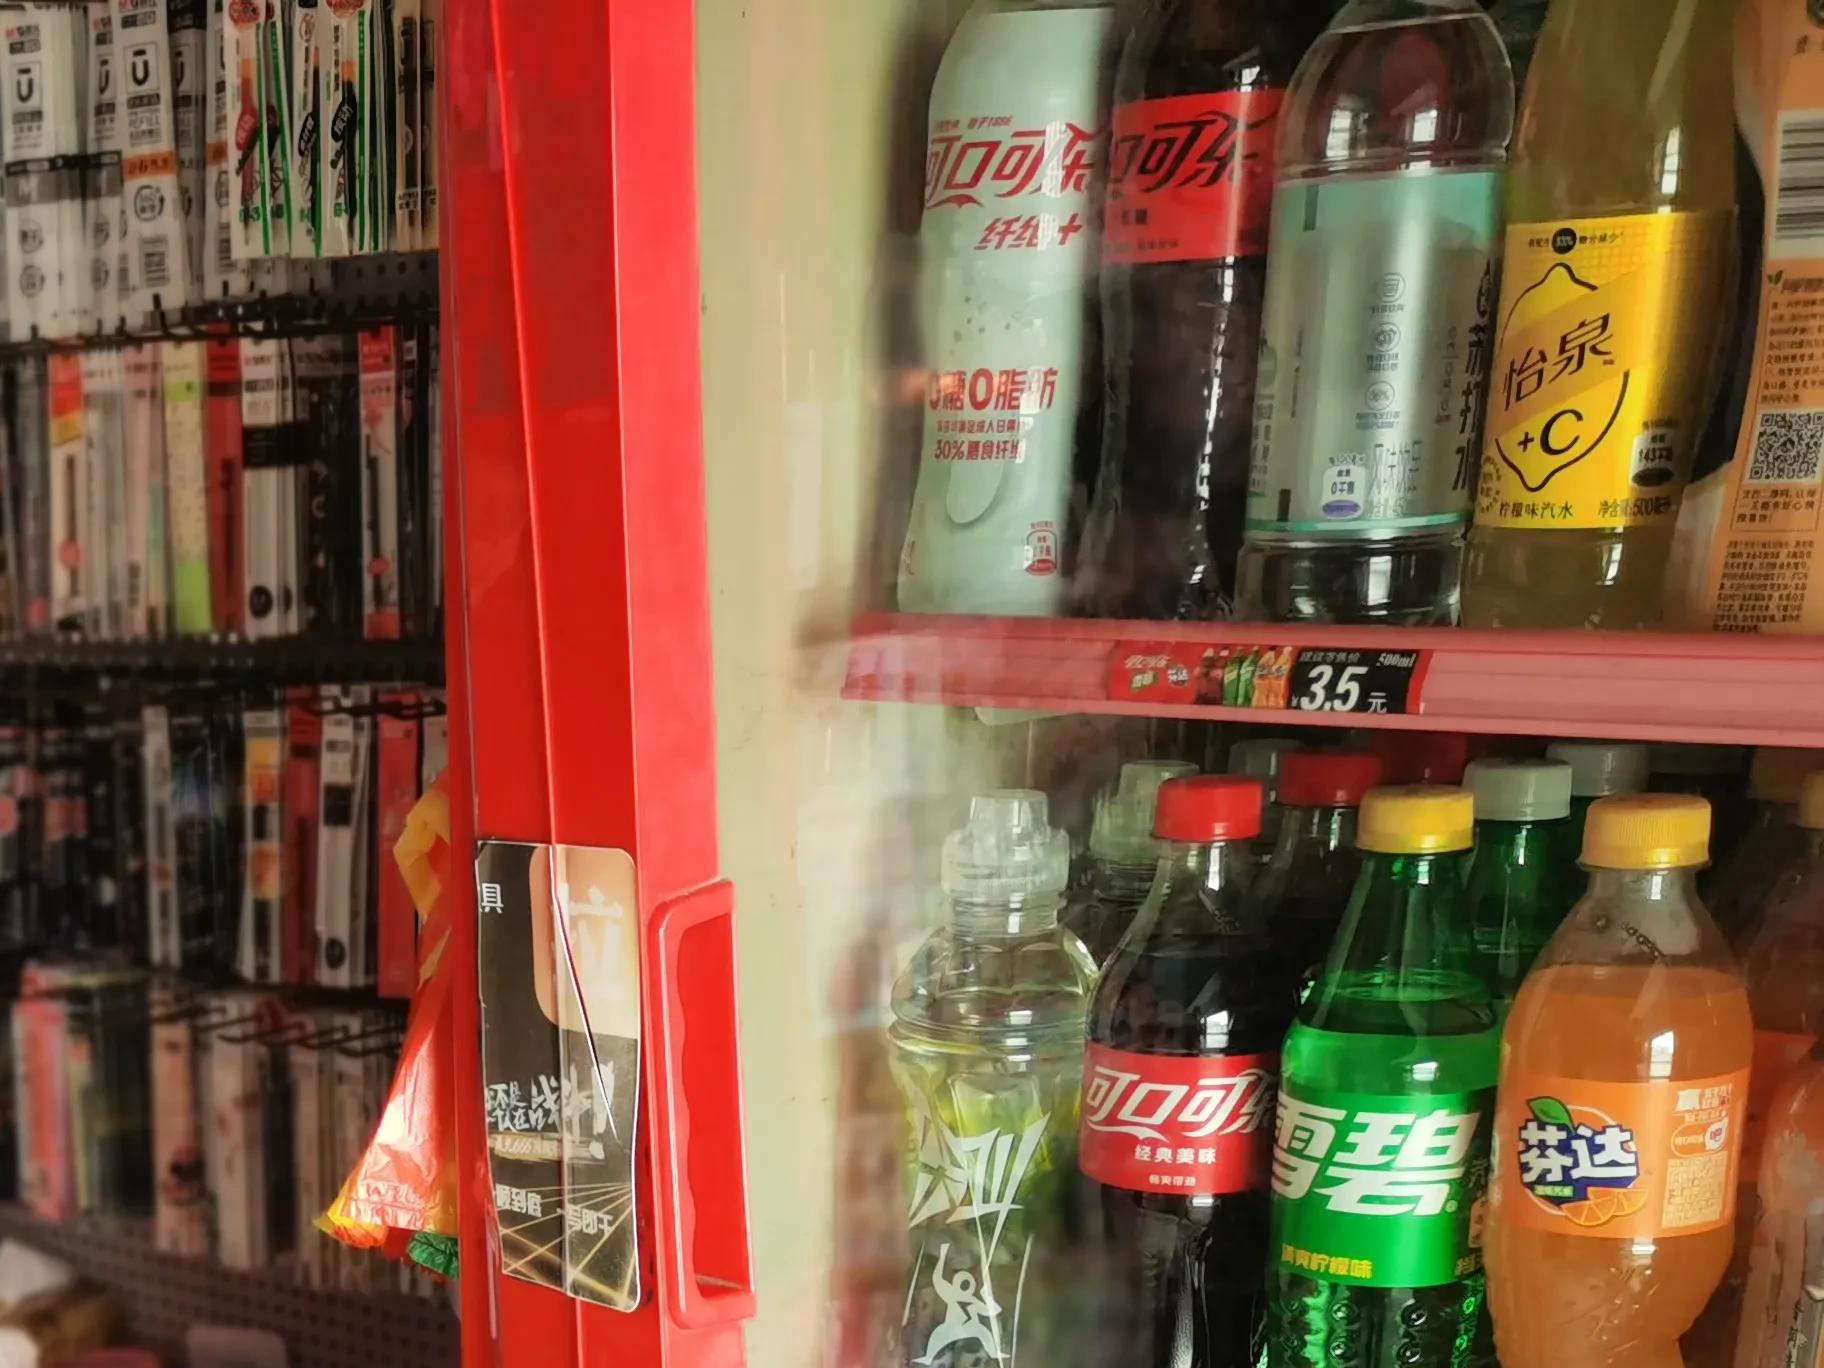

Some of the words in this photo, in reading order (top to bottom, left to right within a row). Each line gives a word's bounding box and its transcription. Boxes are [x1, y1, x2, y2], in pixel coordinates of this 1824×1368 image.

[1502, 312, 1613, 411] 怡泉
[1499, 500, 1574, 520] 柠檬味汽水
[1376, 652, 1416, 668] 500ml
[1367, 691, 1389, 714] 元
[1086, 1066, 1273, 1142] 可口可乐
[1134, 1144, 1217, 1165] 经典美味
[1270, 1091, 1481, 1216] 雪碧
[1519, 1120, 1637, 1183] 芬达
